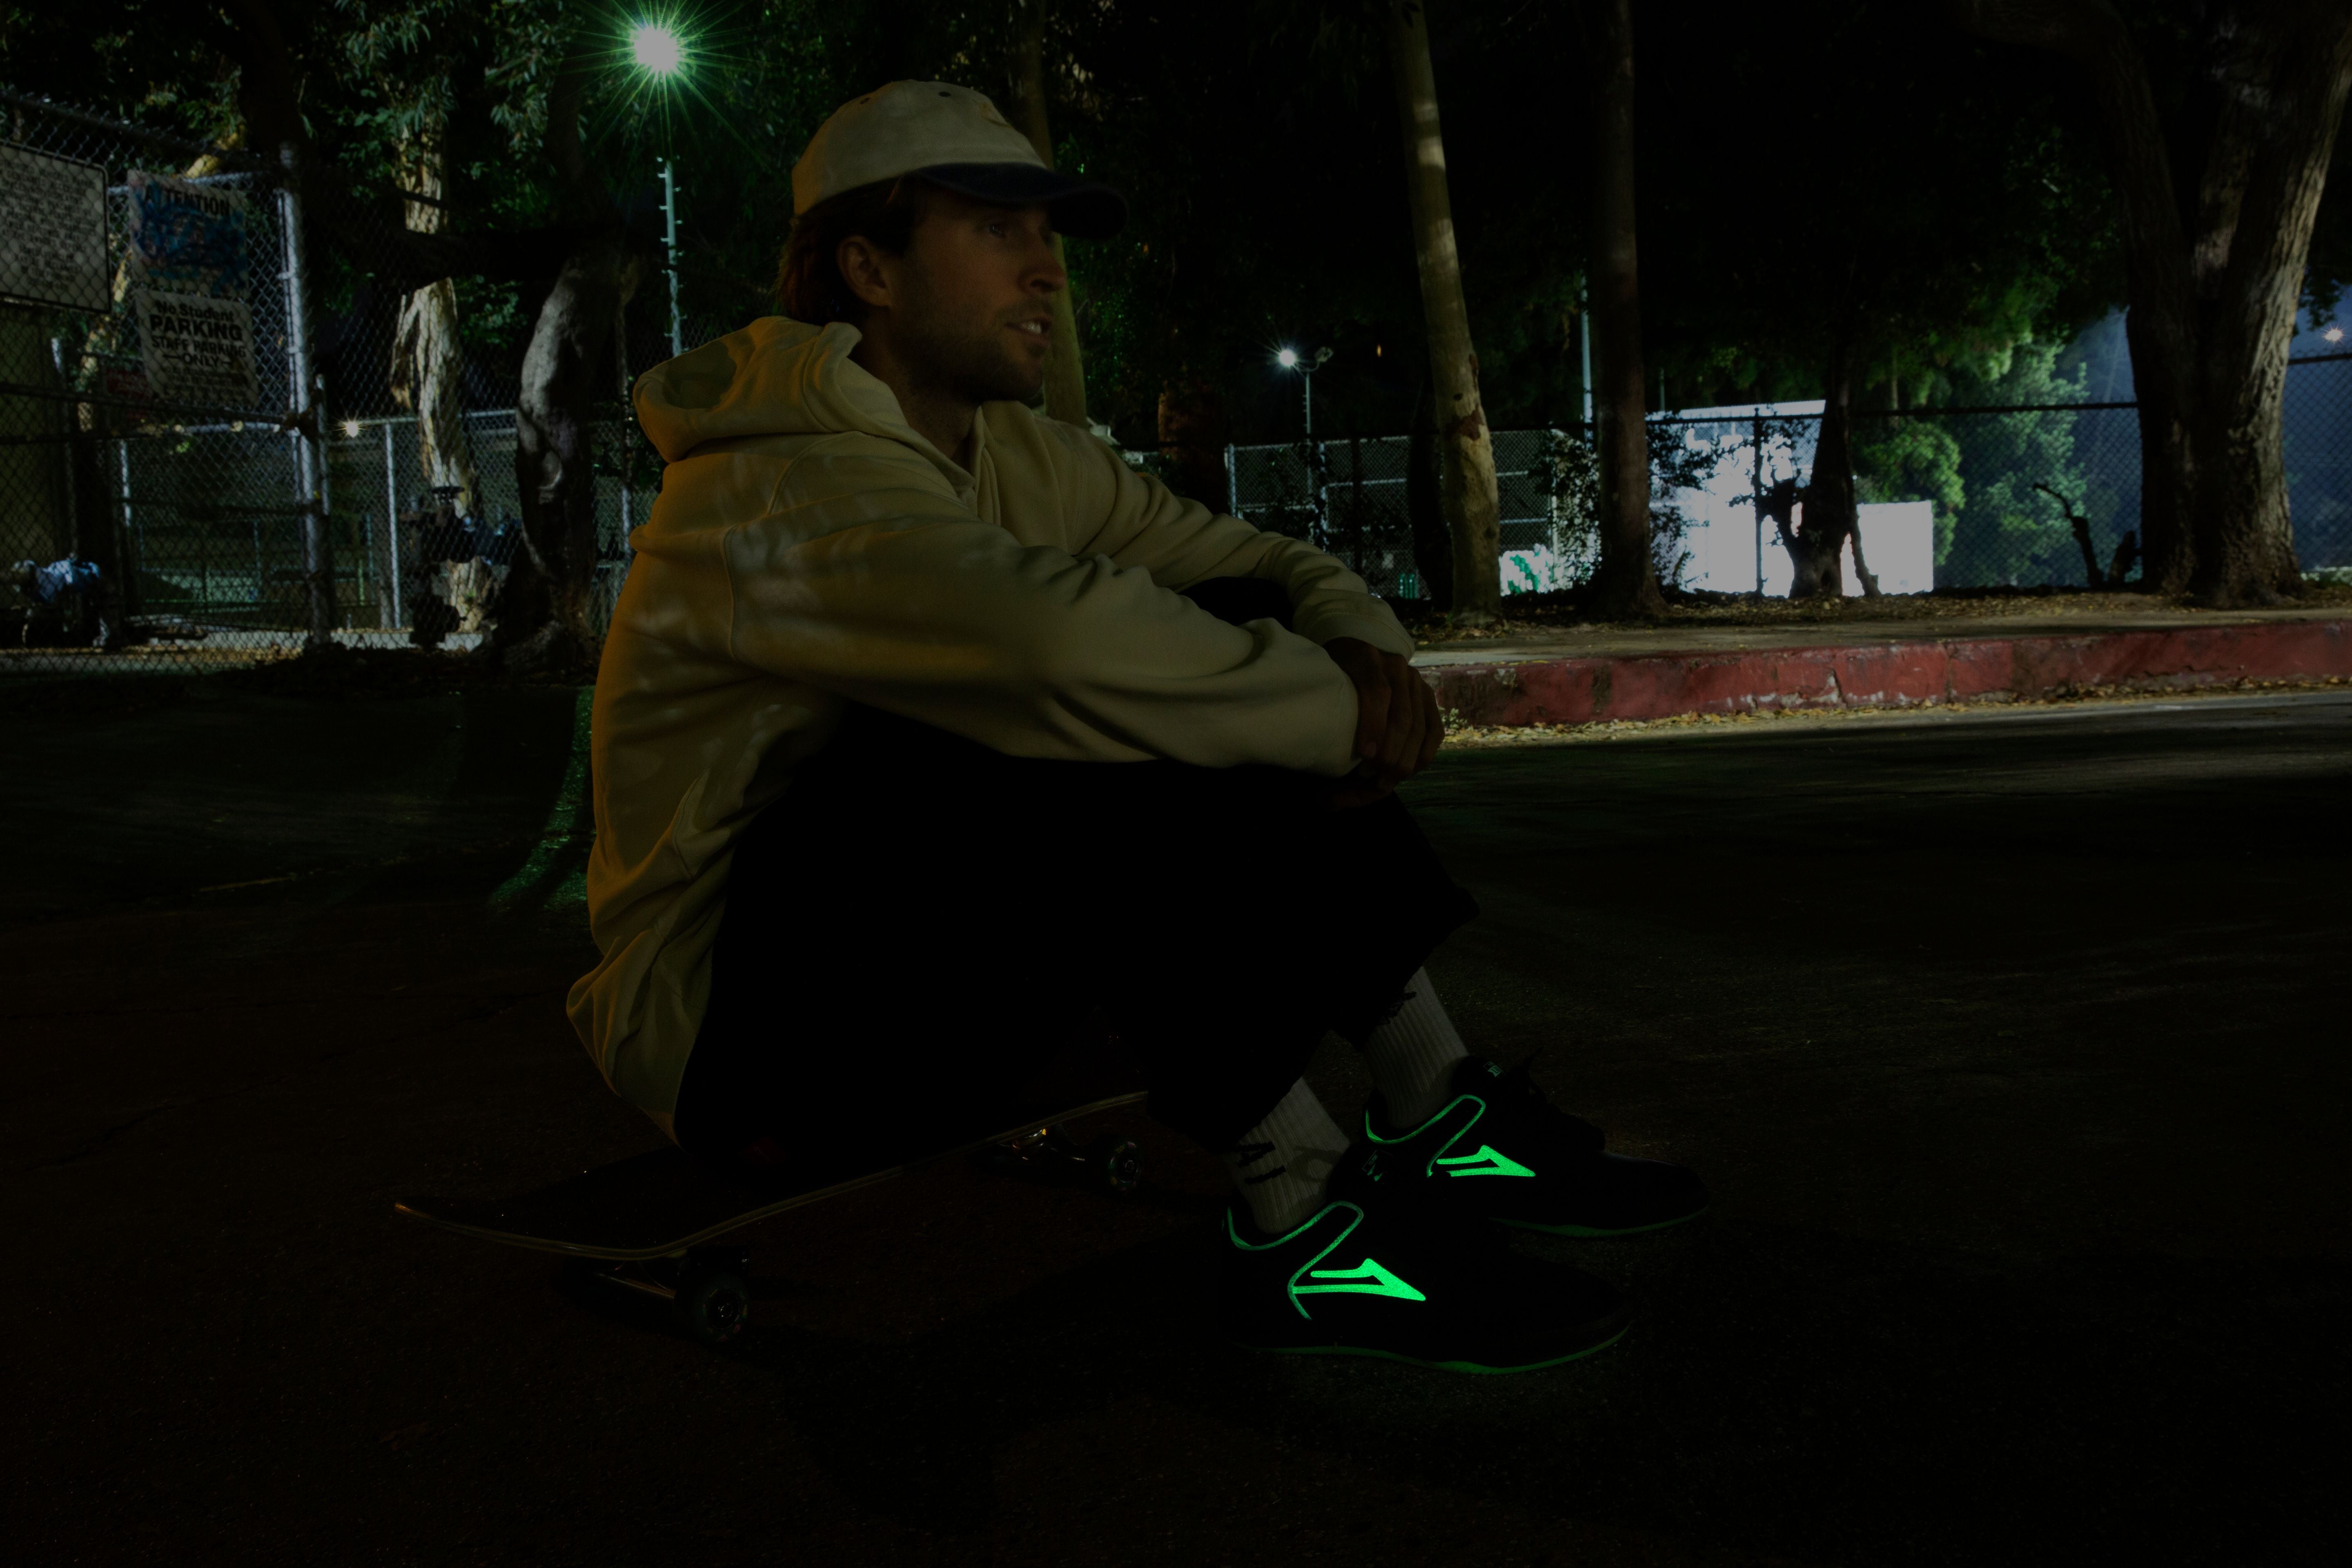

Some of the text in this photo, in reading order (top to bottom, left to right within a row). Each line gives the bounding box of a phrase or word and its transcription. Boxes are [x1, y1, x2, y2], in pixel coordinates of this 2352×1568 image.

[155, 300, 234, 322] No Student
[149, 314, 243, 341] PARKING
[151, 335, 246, 357] STAFF PARKING
[183, 353, 219, 366] ONLY
